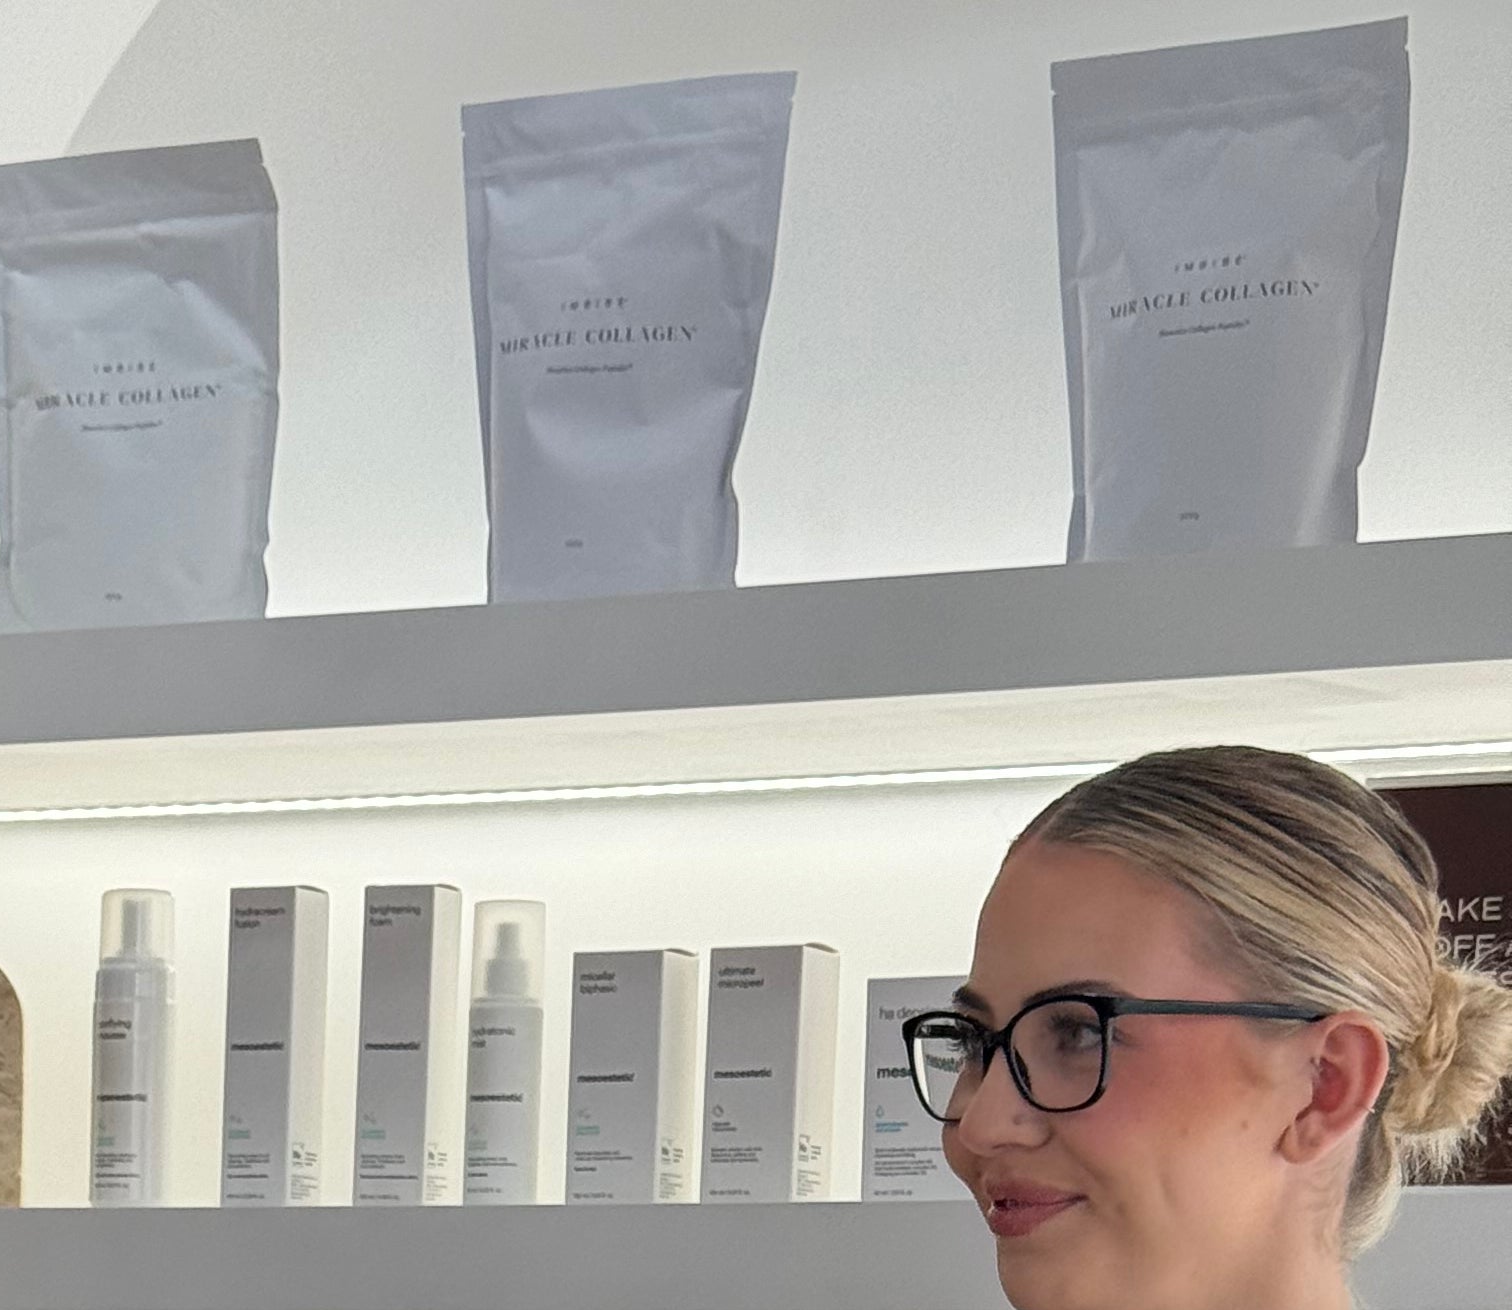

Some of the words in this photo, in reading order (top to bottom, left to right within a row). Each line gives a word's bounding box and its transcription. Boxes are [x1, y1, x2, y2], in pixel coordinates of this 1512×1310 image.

[1110, 291, 1189, 319] MIRACLE
[500, 331, 576, 354] MIRACLE
[1438, 896, 1503, 922] AKE
